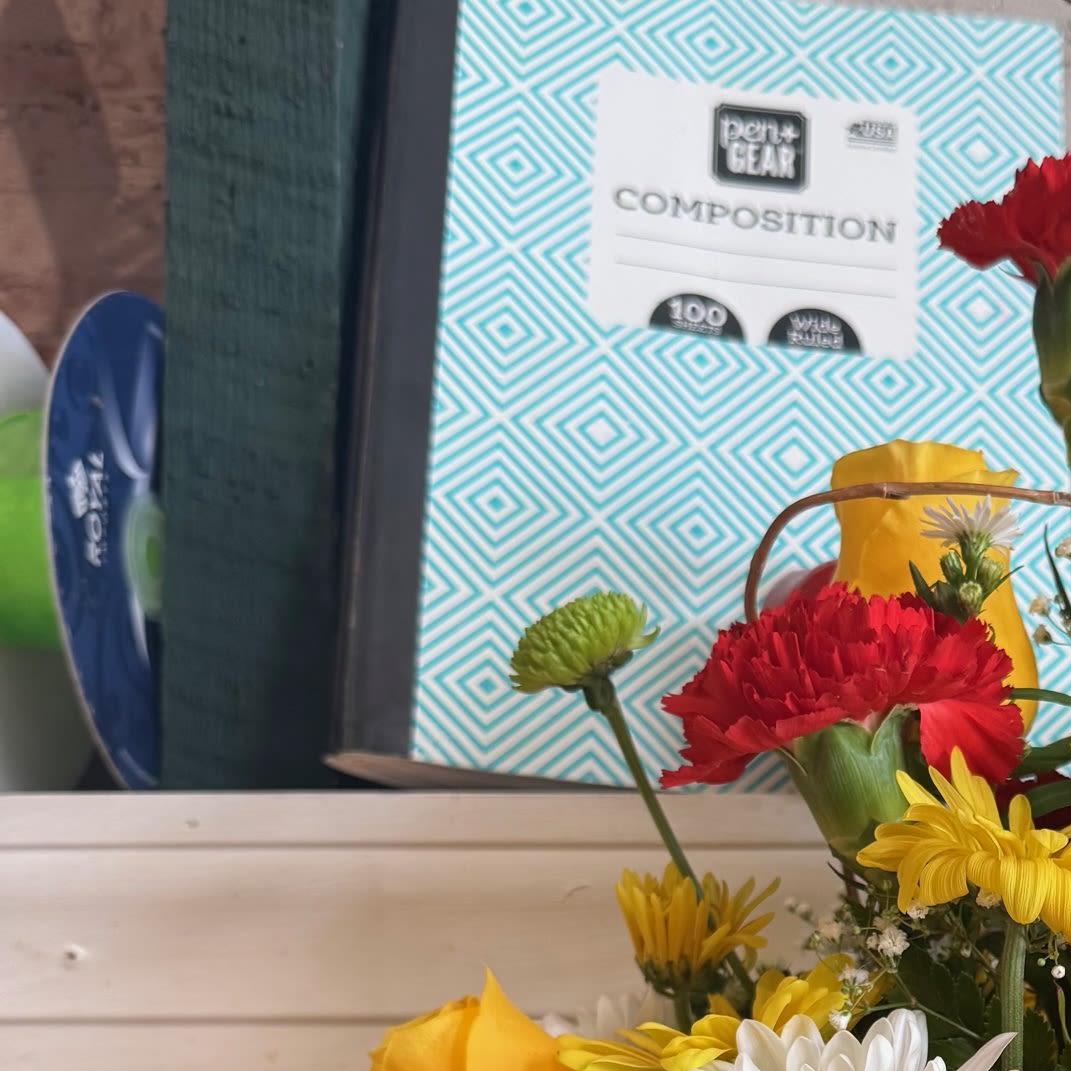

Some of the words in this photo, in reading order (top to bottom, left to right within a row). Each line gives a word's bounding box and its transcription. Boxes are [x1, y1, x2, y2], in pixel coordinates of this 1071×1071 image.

[726, 142, 796, 179] GEAR
[614, 187, 897, 244] COMPOSITION
[669, 297, 728, 327] 100
